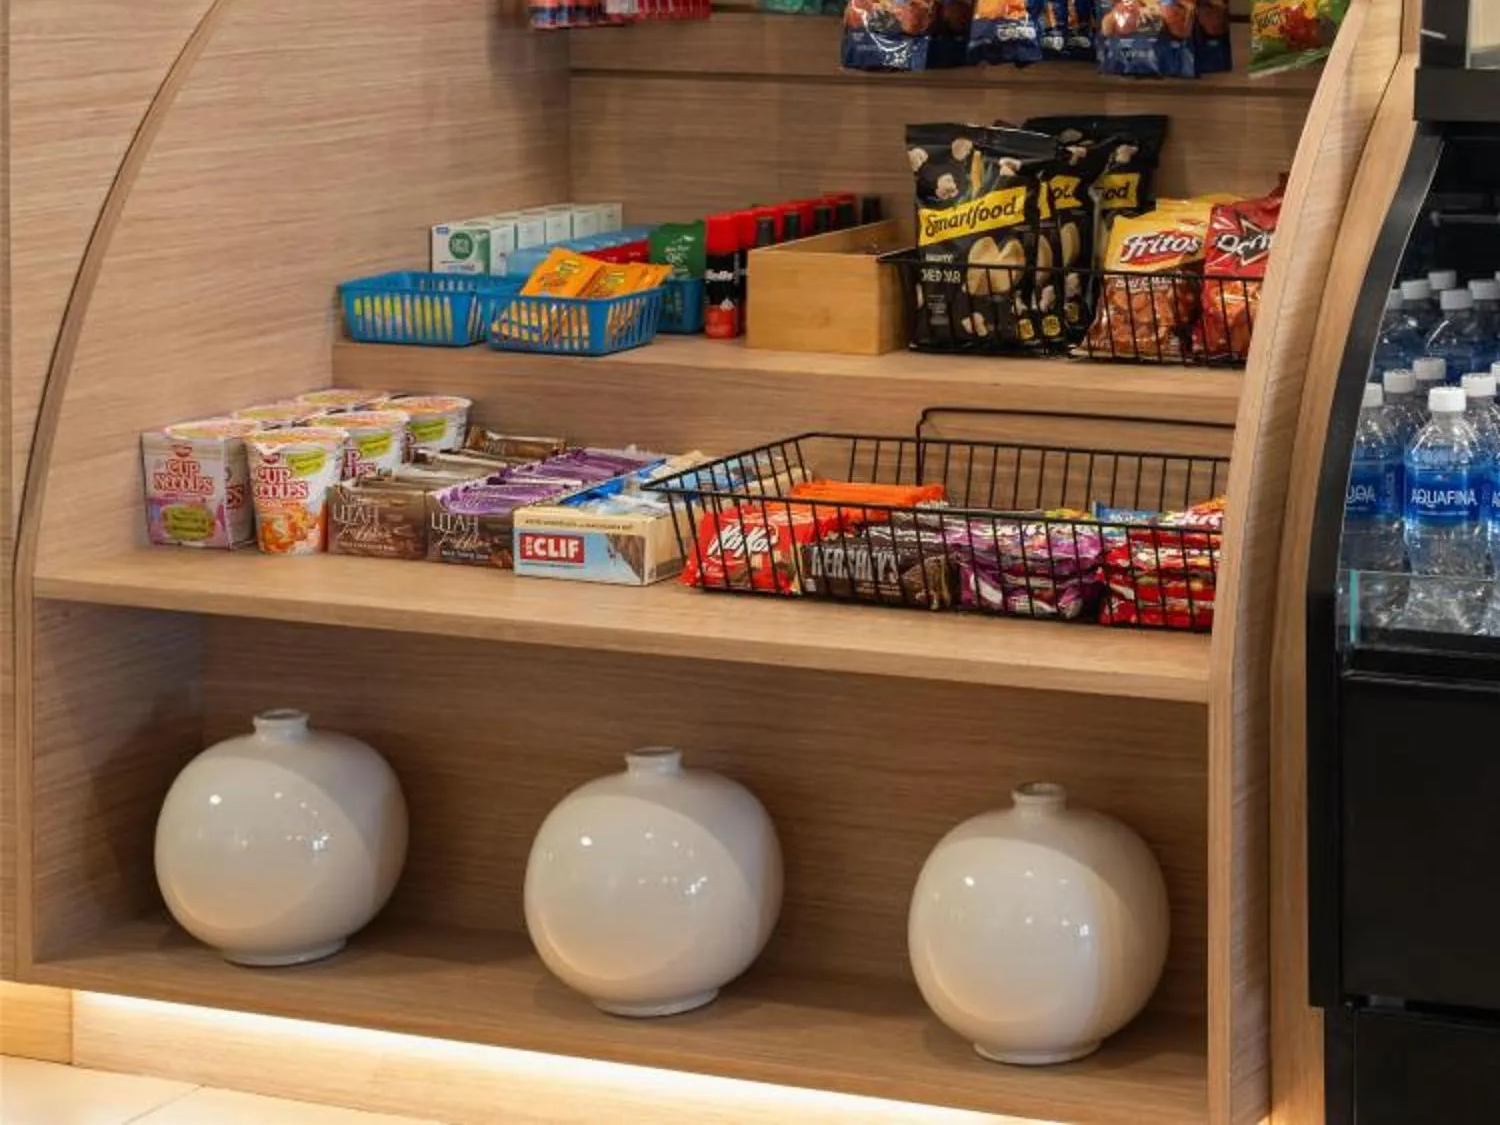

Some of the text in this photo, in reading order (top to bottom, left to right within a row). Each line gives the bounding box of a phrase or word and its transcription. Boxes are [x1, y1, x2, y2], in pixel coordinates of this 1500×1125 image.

[924, 198, 1021, 237] Smartfood
[1119, 233, 1200, 263] Fritos
[1411, 487, 1478, 509] AQUAFINA
[533, 536, 580, 559] CLIF
